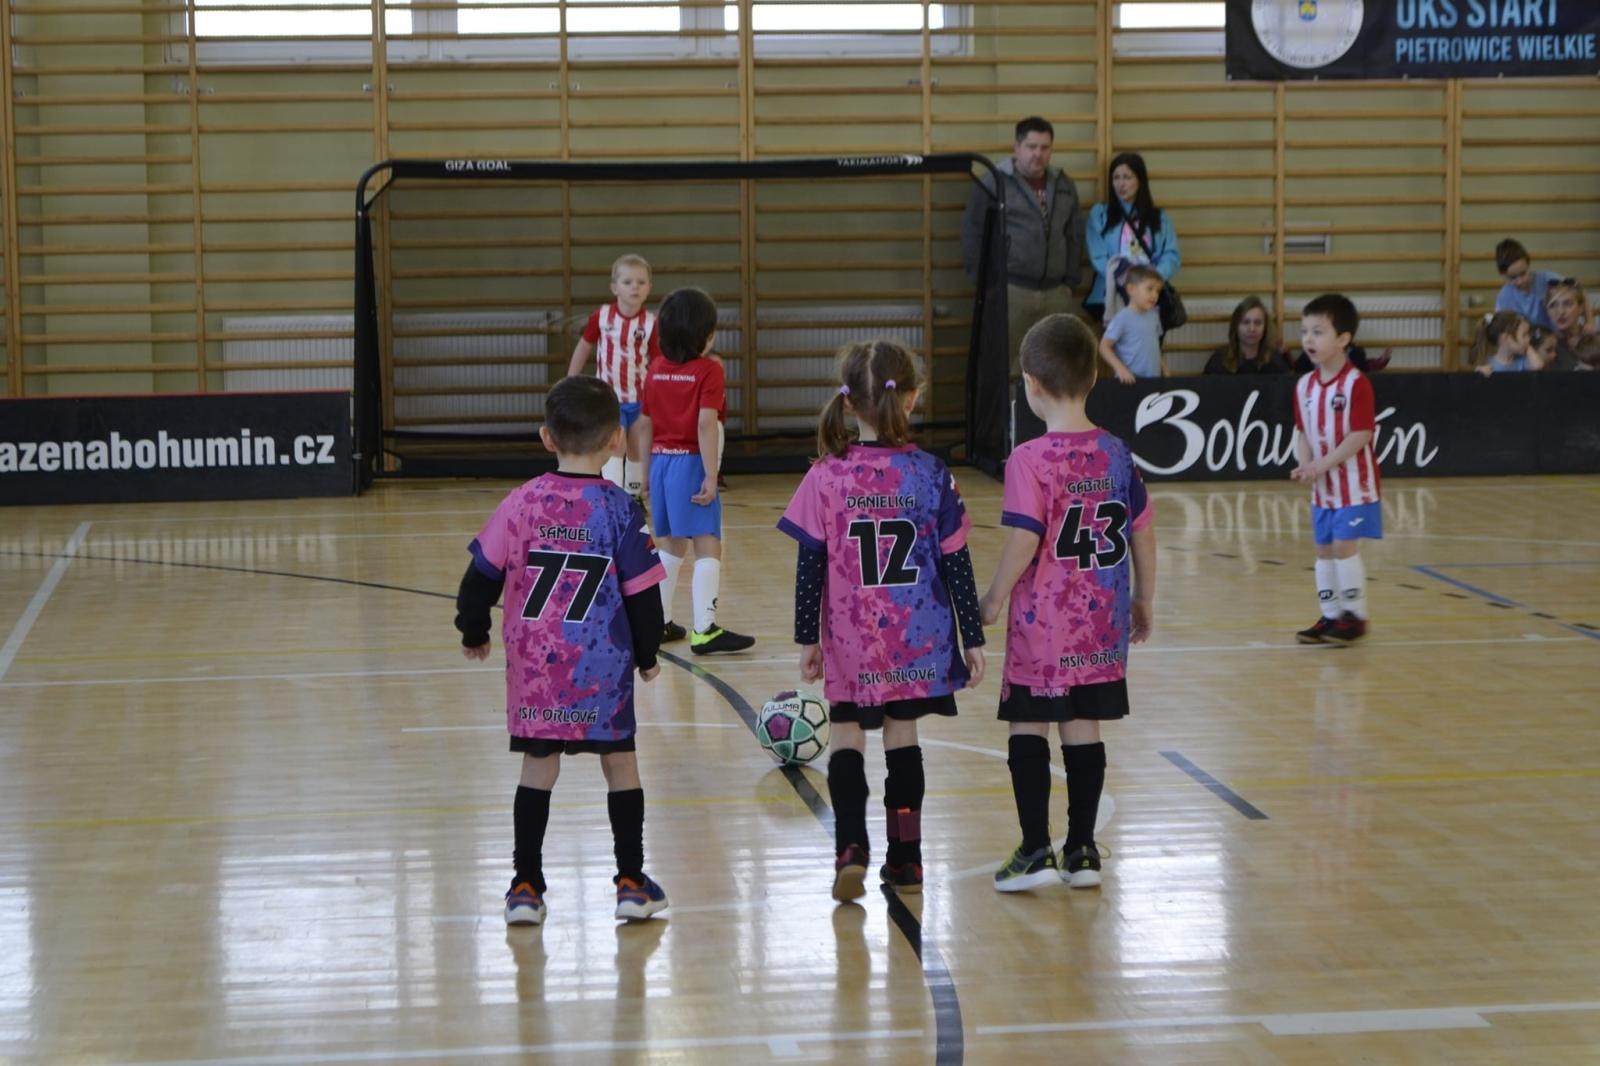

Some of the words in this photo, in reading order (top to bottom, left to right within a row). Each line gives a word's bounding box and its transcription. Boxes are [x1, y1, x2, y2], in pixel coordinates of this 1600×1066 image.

[1396, 0, 1458, 28] UKS
[1466, 0, 1558, 28] START
[1396, 35, 1512, 62] PIETROWICE
[1517, 33, 1597, 62] WIELKIE
[445, 159, 474, 171] GIZA
[476, 159, 511, 171] GOAL
[1131, 388, 1439, 475] Bohuín
[0, 428, 336, 472] azenabohumin.cz
[1067, 477, 1116, 494] GABRIEL
[847, 496, 915, 509] DANIELKA
[539, 525, 594, 542] SAMUEL
[1055, 500, 1128, 571] 43
[847, 518, 920, 588] 12
[521, 549, 613, 623] 77
[1059, 655, 1085, 669] MSK
[858, 671, 881, 685] MSK
[519, 706, 537, 721] SK
